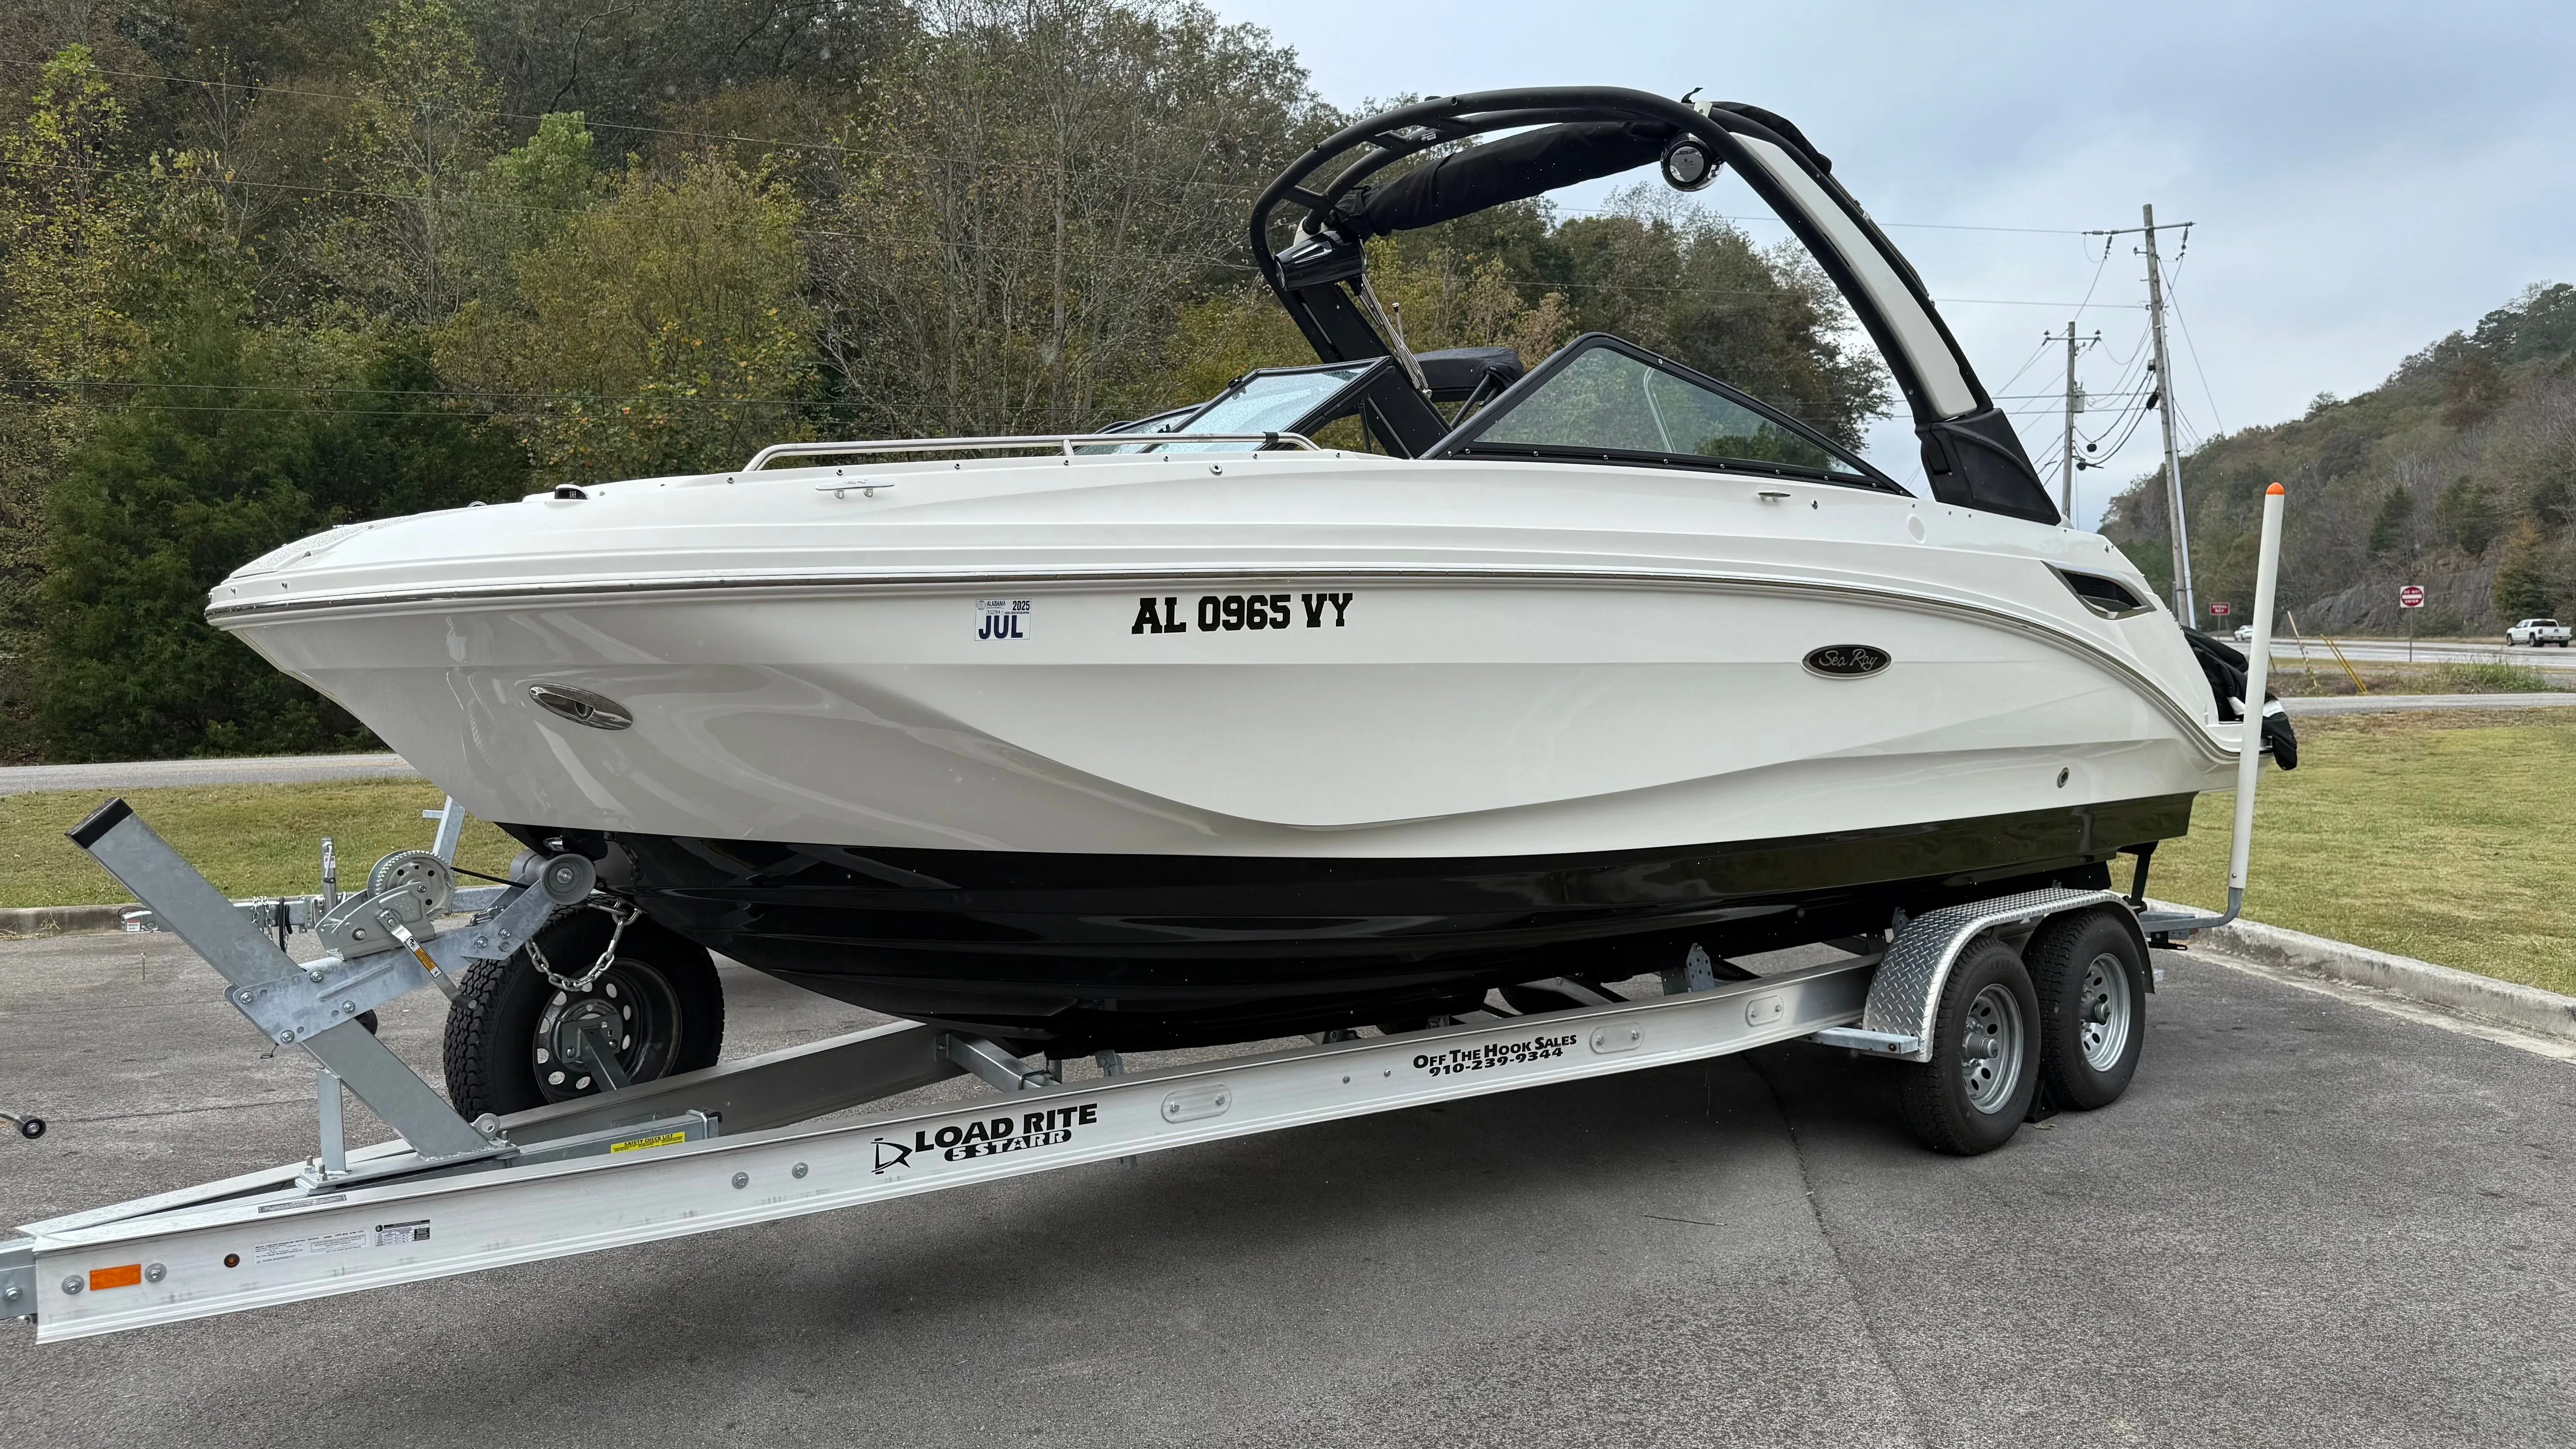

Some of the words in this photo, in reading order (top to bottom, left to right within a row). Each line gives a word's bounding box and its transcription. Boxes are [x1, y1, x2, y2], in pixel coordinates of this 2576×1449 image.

[1012, 600, 1030, 611] 2025
[1132, 597, 1187, 634] AL
[1198, 594, 1291, 632] 0965
[1302, 593, 1353, 628] VY
[978, 615, 1023, 639] JUL
[1819, 650, 1848, 666] Sea
[1849, 649, 1878, 671] Ray
[1413, 1054, 1446, 1068] OFF
[1449, 1049, 1481, 1063] THE
[1484, 1041, 1532, 1058] HOOK
[1535, 1035, 1577, 1050] SALES
[1429, 1047, 1563, 1077] 910-239-9344
[915, 1117, 1014, 1153] LOAD
[1023, 1103, 1098, 1135] RITE
[952, 1147, 966, 1160] 5
[975, 1130, 1065, 1157] STARR
